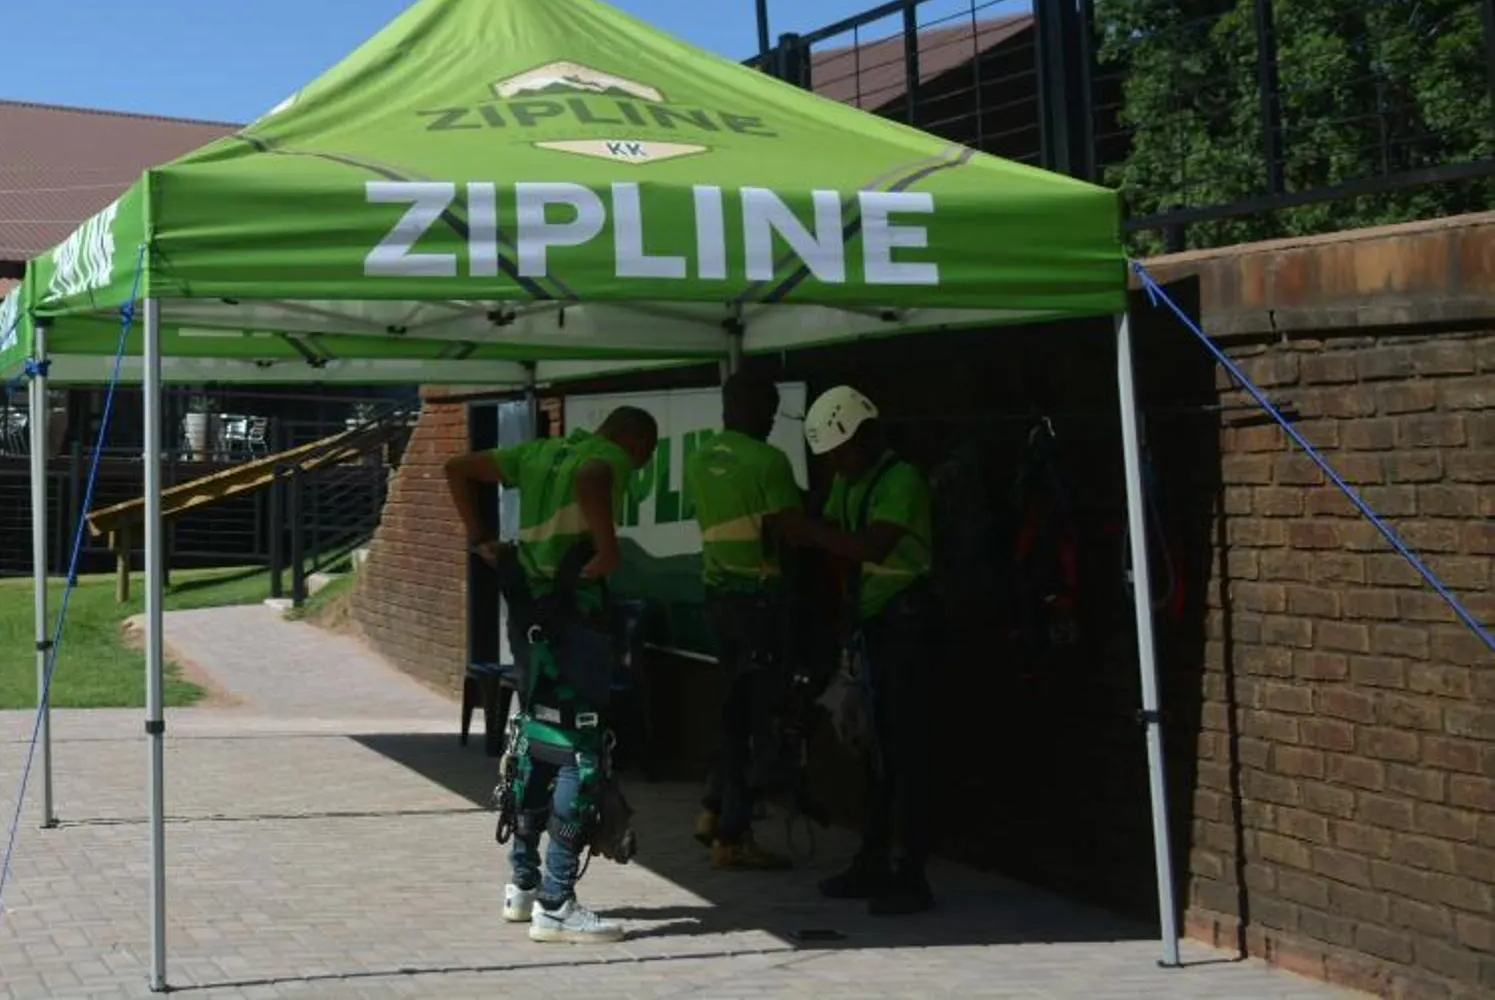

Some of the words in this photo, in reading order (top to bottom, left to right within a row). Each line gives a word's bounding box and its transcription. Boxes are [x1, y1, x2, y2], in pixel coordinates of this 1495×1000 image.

[417, 100, 777, 138] ZIPLINE
[606, 140, 647, 158] KK
[363, 180, 940, 285] ZIPLINE
